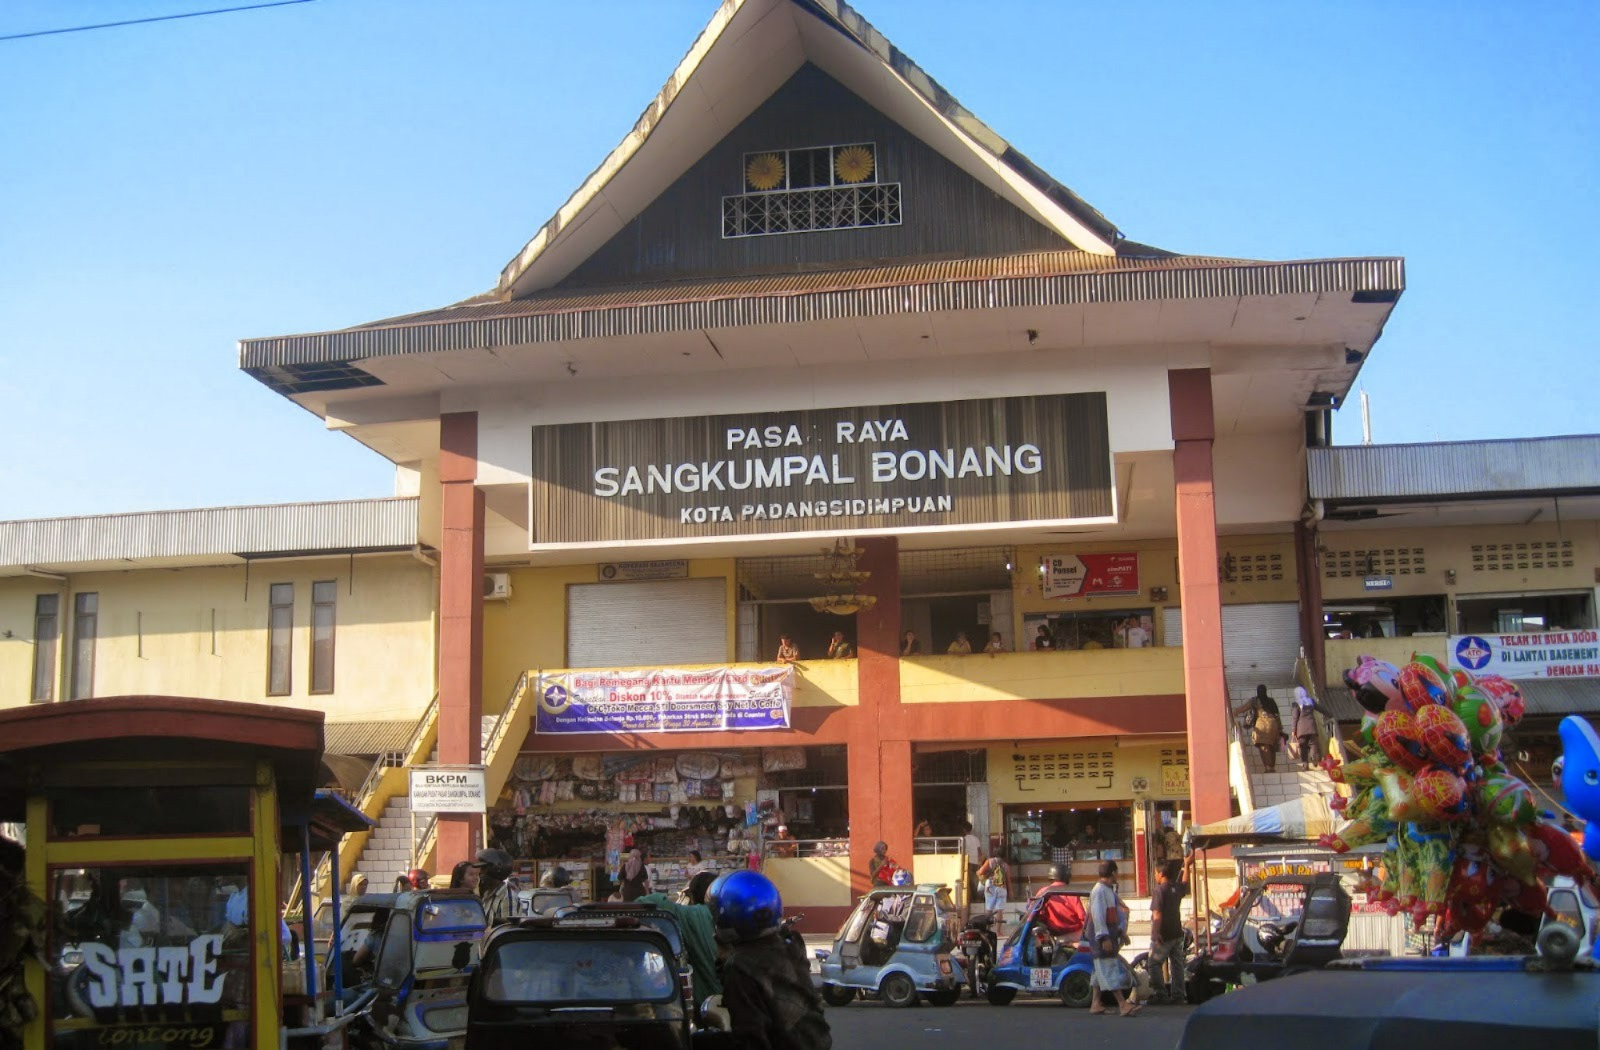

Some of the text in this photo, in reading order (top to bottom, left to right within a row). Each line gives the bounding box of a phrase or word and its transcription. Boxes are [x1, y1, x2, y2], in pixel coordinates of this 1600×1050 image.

[836, 418, 909, 445] RAYA
[593, 443, 1043, 498] SANGKUMPAL BONANG
[680, 495, 953, 525] KOTA PADANGSIDIMPUAN
[1499, 631, 1598, 646] TELAH DI BUKA DOOR
[1501, 648, 1599, 662] DI LANTAI BASEMENT
[1546, 665, 1584, 676] DENGAN
[575, 679, 597, 689] Bagi
[599, 677, 651, 690] Pemegang
[652, 675, 680, 686] Kartu
[681, 673, 723, 685] Member
[609, 692, 647, 703] Diskon
[651, 689, 673, 701] 10%
[734, 702, 749, 711] Net
[750, 702, 758, 711] &
[426, 775, 467, 784] BKPM
[79, 933, 229, 1008] SATE
